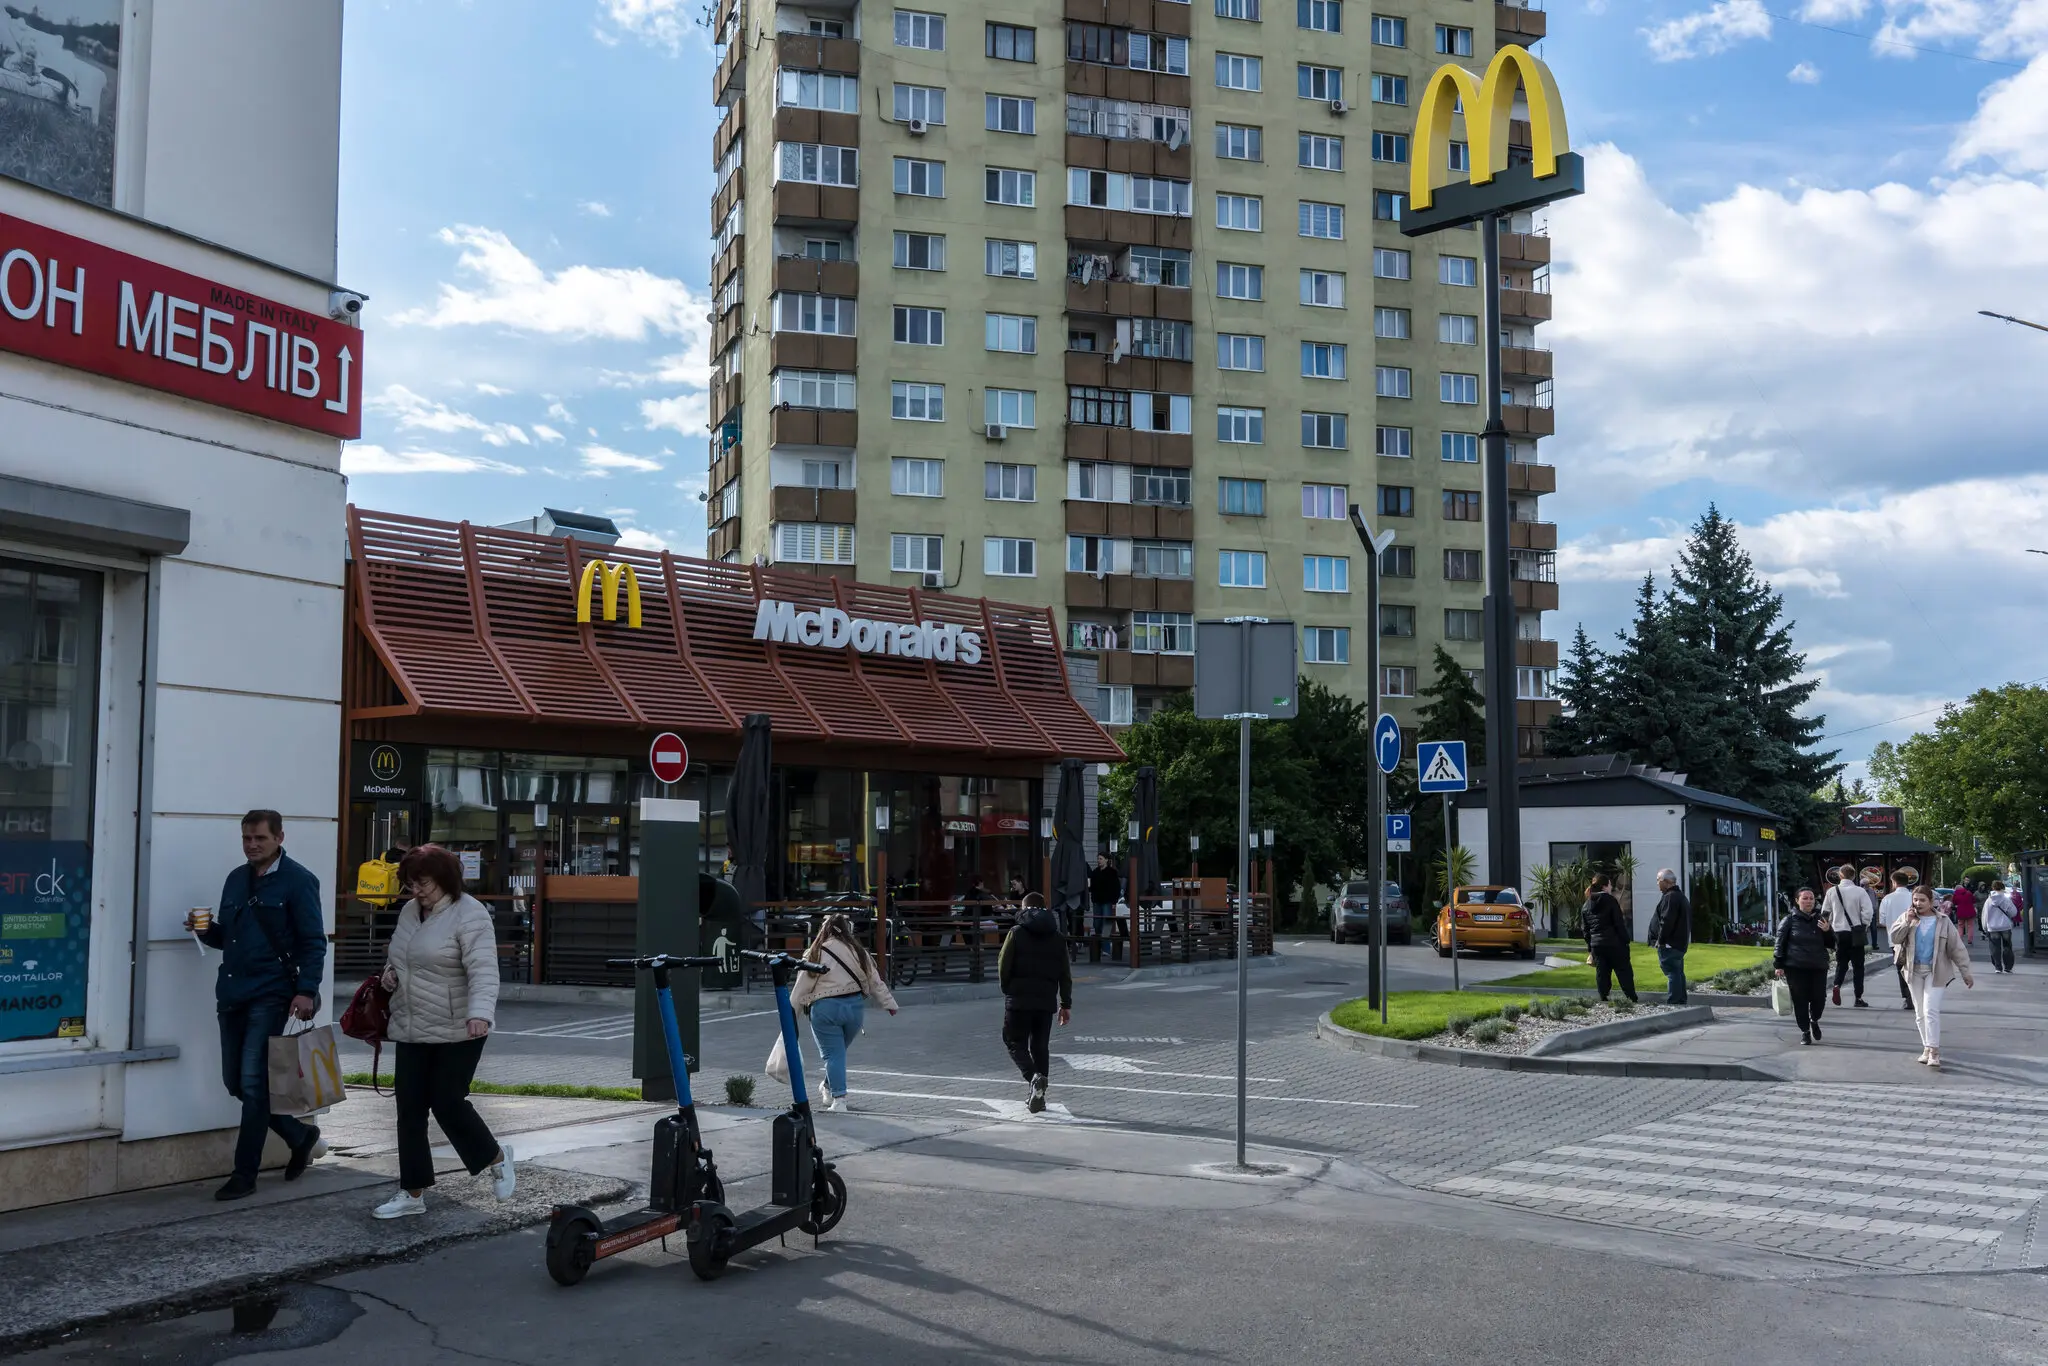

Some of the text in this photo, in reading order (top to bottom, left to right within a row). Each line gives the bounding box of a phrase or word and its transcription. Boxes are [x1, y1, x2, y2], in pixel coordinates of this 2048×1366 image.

[211, 288, 318, 333] MADE IN ITALY
[0, 249, 321, 399] ОН МЕБЛІВ
[753, 599, 982, 665] McDonald's
[363, 784, 406, 796] McDelivery
[1393, 819, 1404, 835] P
[3, 914, 26, 922] UNITED
[22, 972, 63, 982] TAILOR
